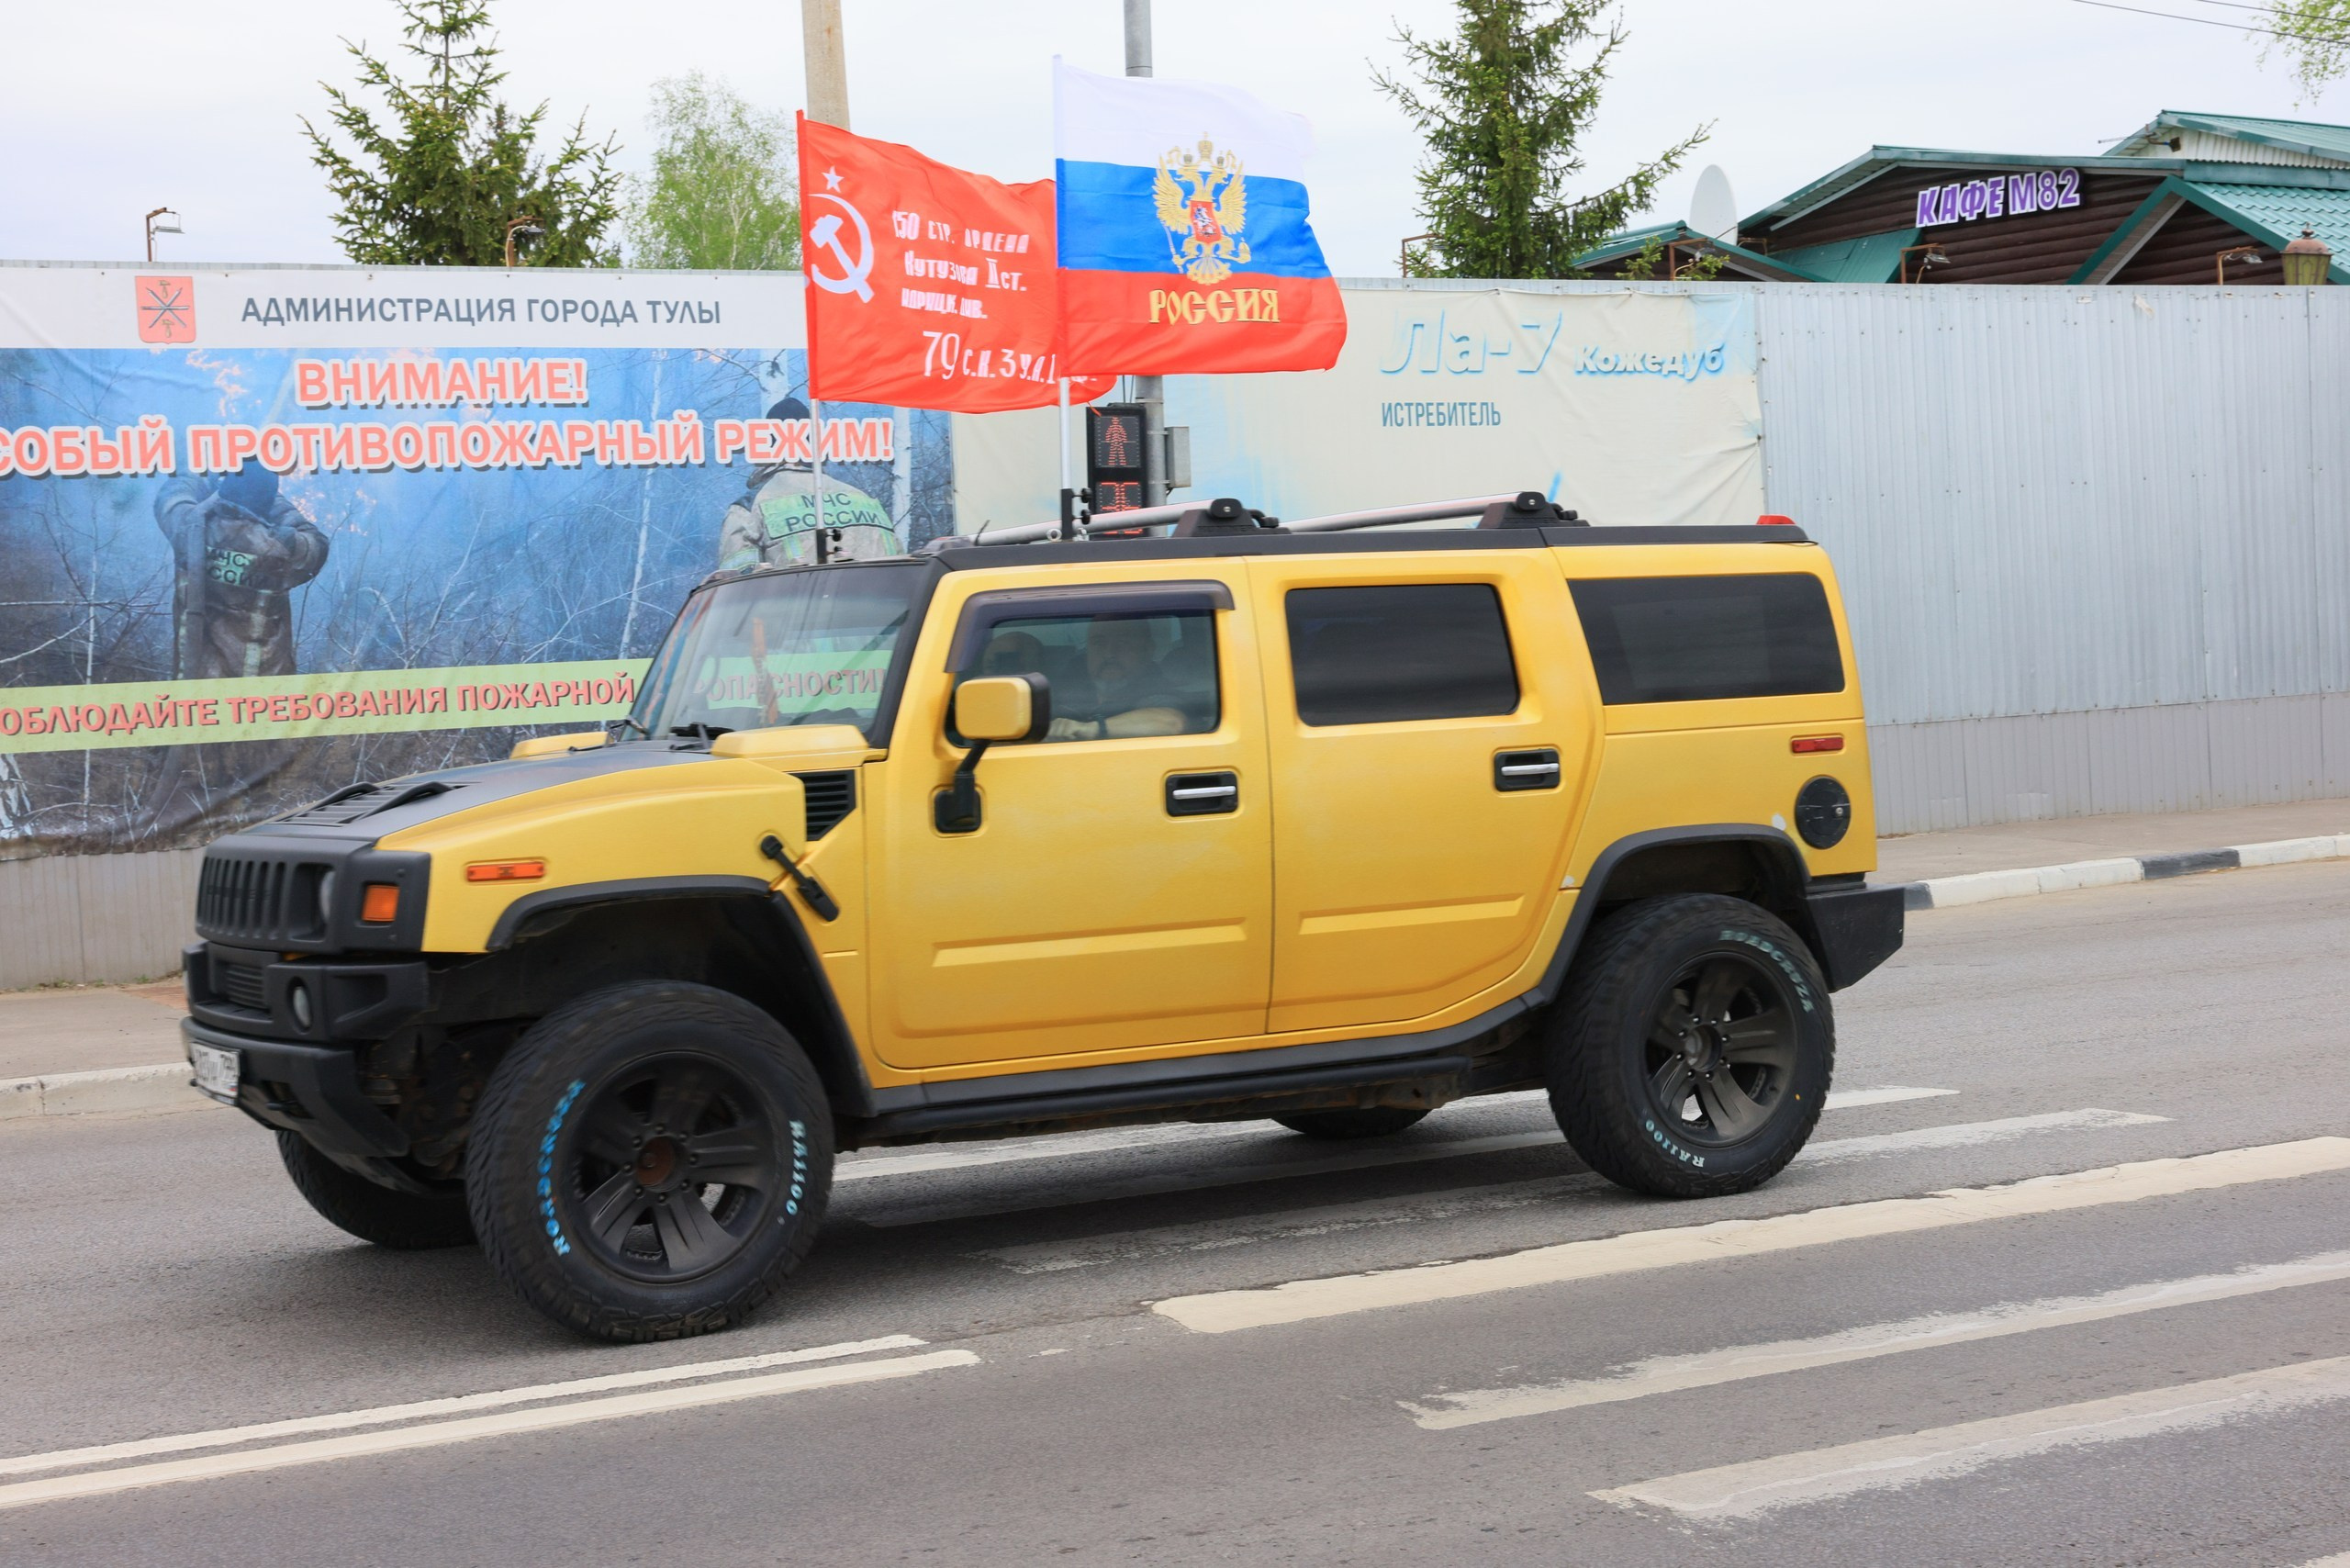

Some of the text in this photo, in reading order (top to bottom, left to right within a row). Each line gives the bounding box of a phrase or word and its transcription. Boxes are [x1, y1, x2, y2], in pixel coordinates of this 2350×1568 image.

[1916, 167, 2080, 228] КАФЕ М82
[891, 210, 920, 241] 150
[241, 296, 722, 328] АДМИНИСТРАЦИЯ ГОРОДА ТУЛЫ
[1148, 287, 1281, 324] РОССИЯ
[923, 330, 960, 380] 79
[1573, 342, 1727, 382] Кожедуб
[296, 358, 588, 405] ВНИМАНИЕ!
[1381, 401, 1502, 428] ИСТРЕБИТЕЛЬ
[189, 410, 705, 472] ПРОТИВОПОЖАРНЫЙ
[715, 417, 895, 468] РЕЖИМ!
[0, 693, 219, 735] ОБЛЮДАЙТЕ
[226, 686, 447, 724] ТРЕБОВАНИЯ
[457, 671, 635, 711] ПОЖАРНОЙ
